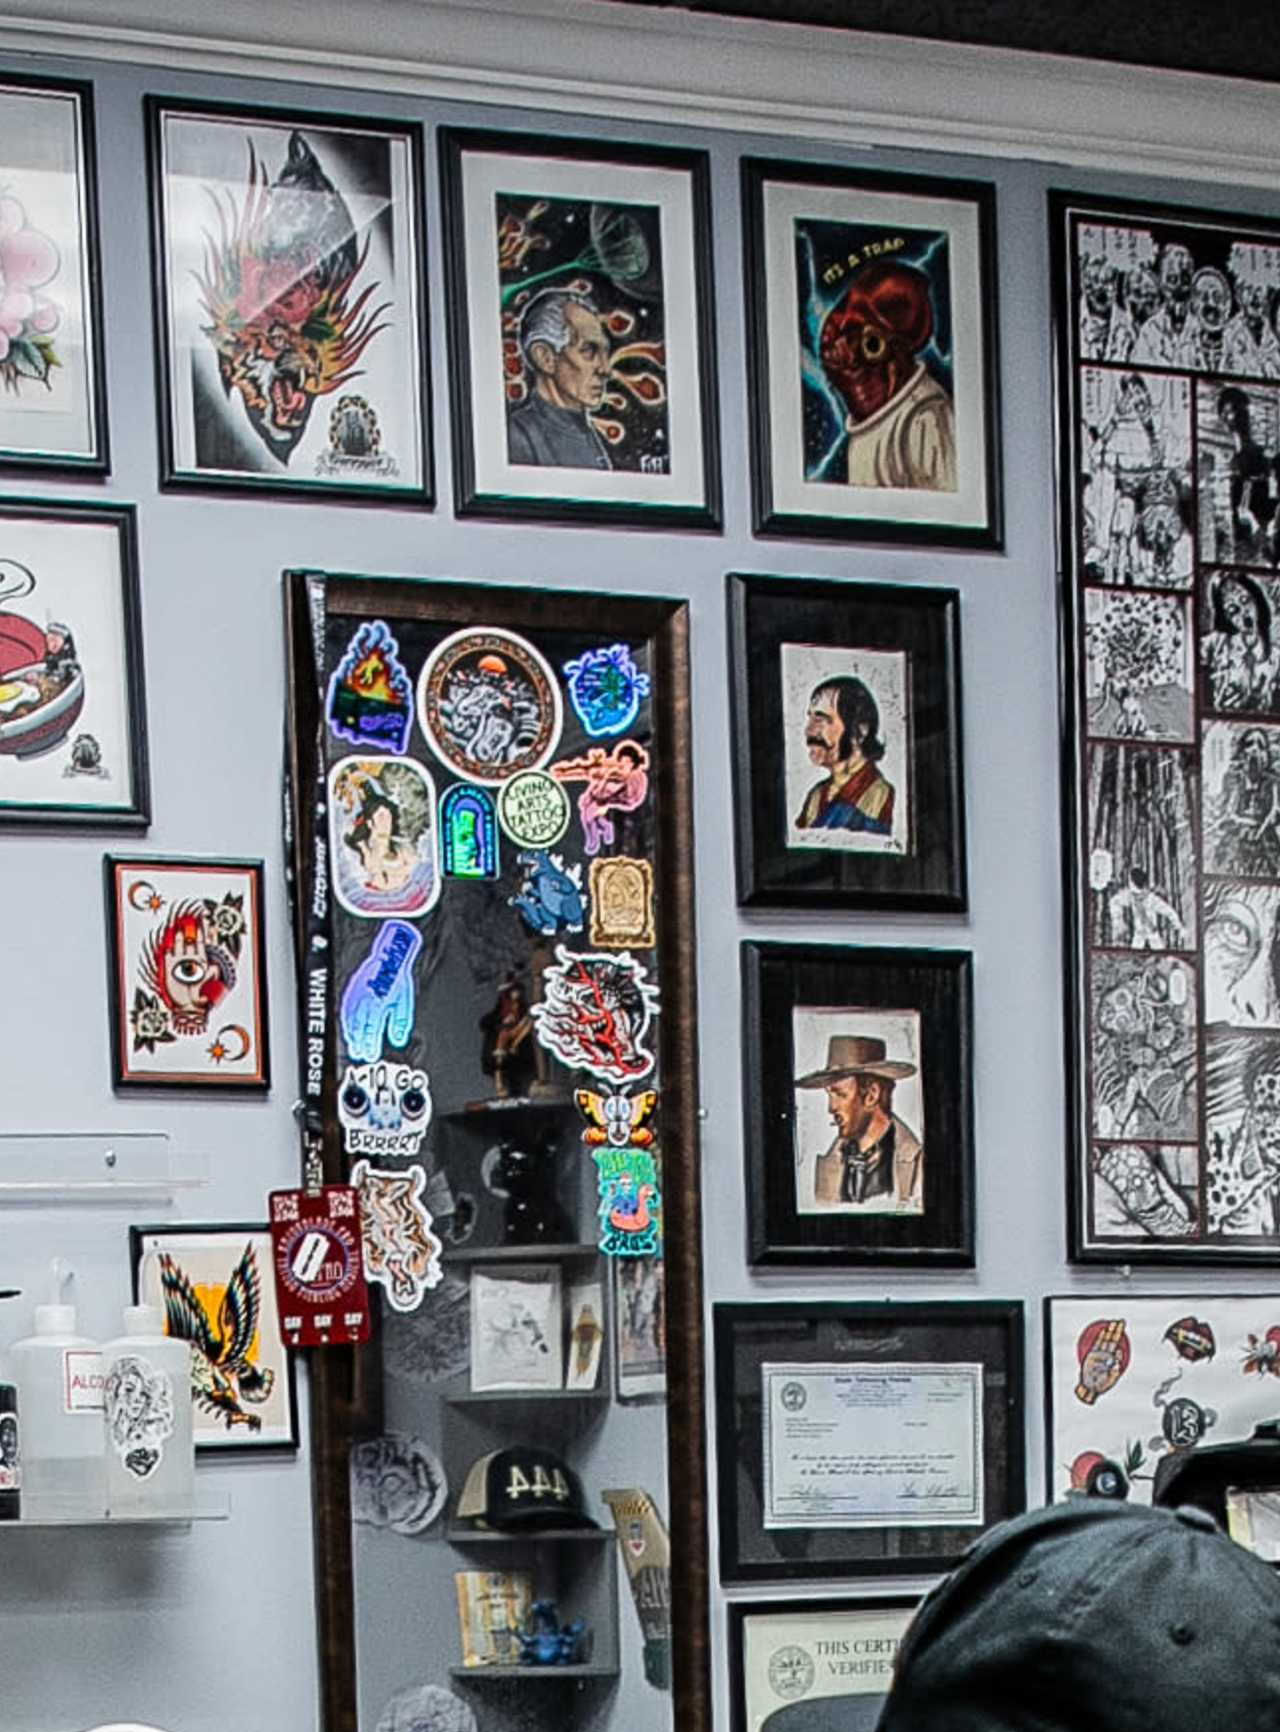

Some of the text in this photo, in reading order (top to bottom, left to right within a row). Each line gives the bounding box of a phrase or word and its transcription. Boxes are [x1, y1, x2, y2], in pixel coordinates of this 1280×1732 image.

[517, 794, 552, 812] ARTS
[509, 804, 564, 828] TATTOO
[521, 821, 558, 840] EXPO
[306, 968, 328, 1096] WHITE ROSE
[817, 1642, 849, 1656] THIS
